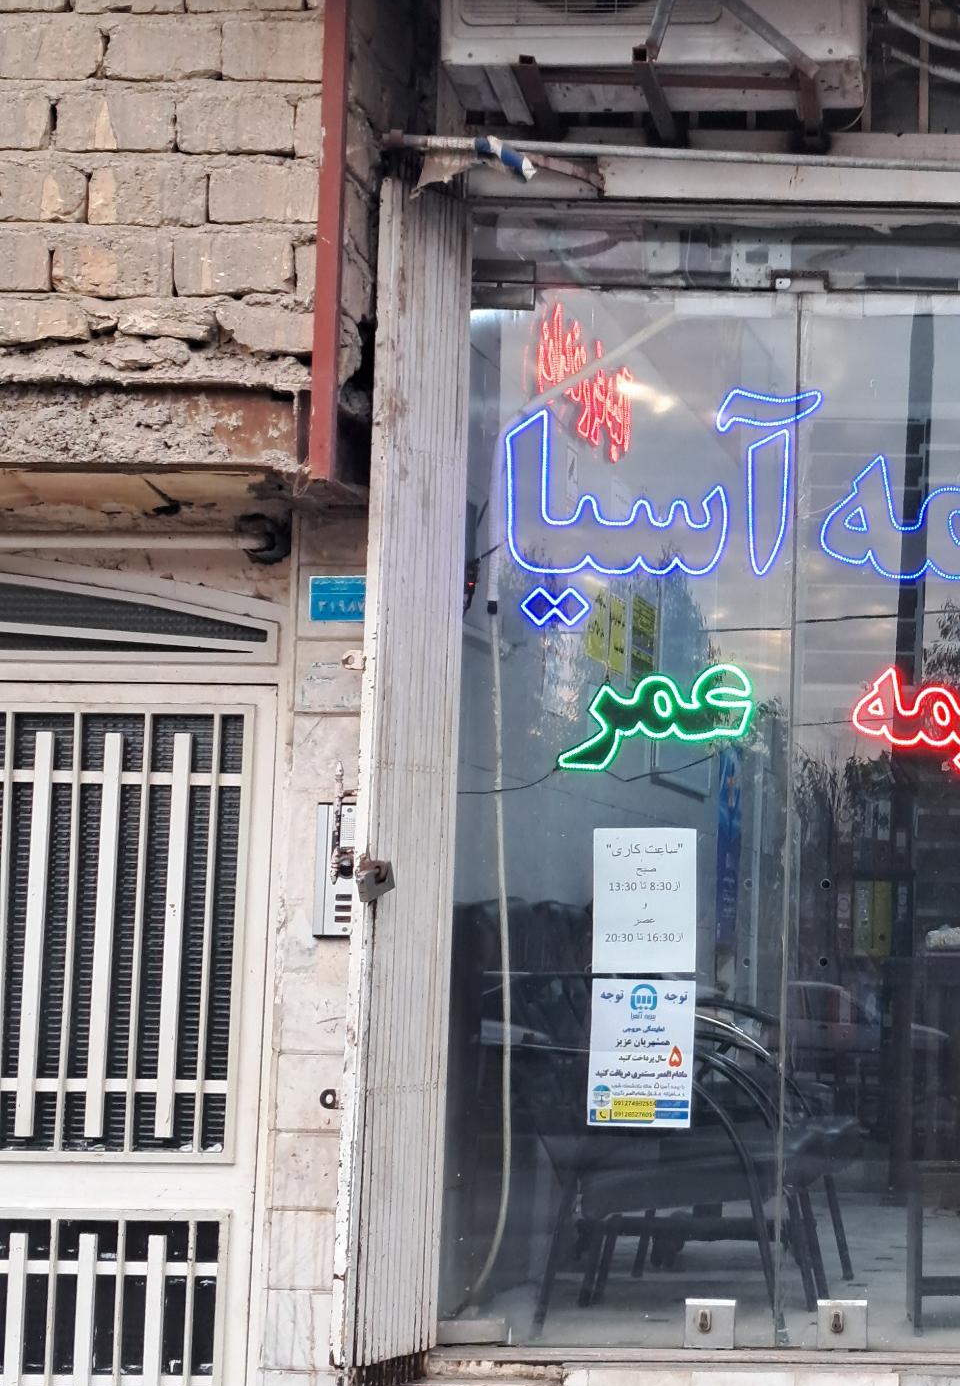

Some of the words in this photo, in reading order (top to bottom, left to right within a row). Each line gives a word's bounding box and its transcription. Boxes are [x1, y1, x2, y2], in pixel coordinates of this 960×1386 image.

[505, 387, 823, 628] آسیا
[556, 663, 753, 772] عمر
[609, 881, 637, 892] 13:30
[649, 881, 672, 891] 8:30
[605, 932, 634, 943] 20:30
[647, 932, 675, 943] 16:30
[600, 990, 624, 1003] توجه
[664, 991, 688, 1004] توجه
[667, 1046, 683, 1068] ۵
